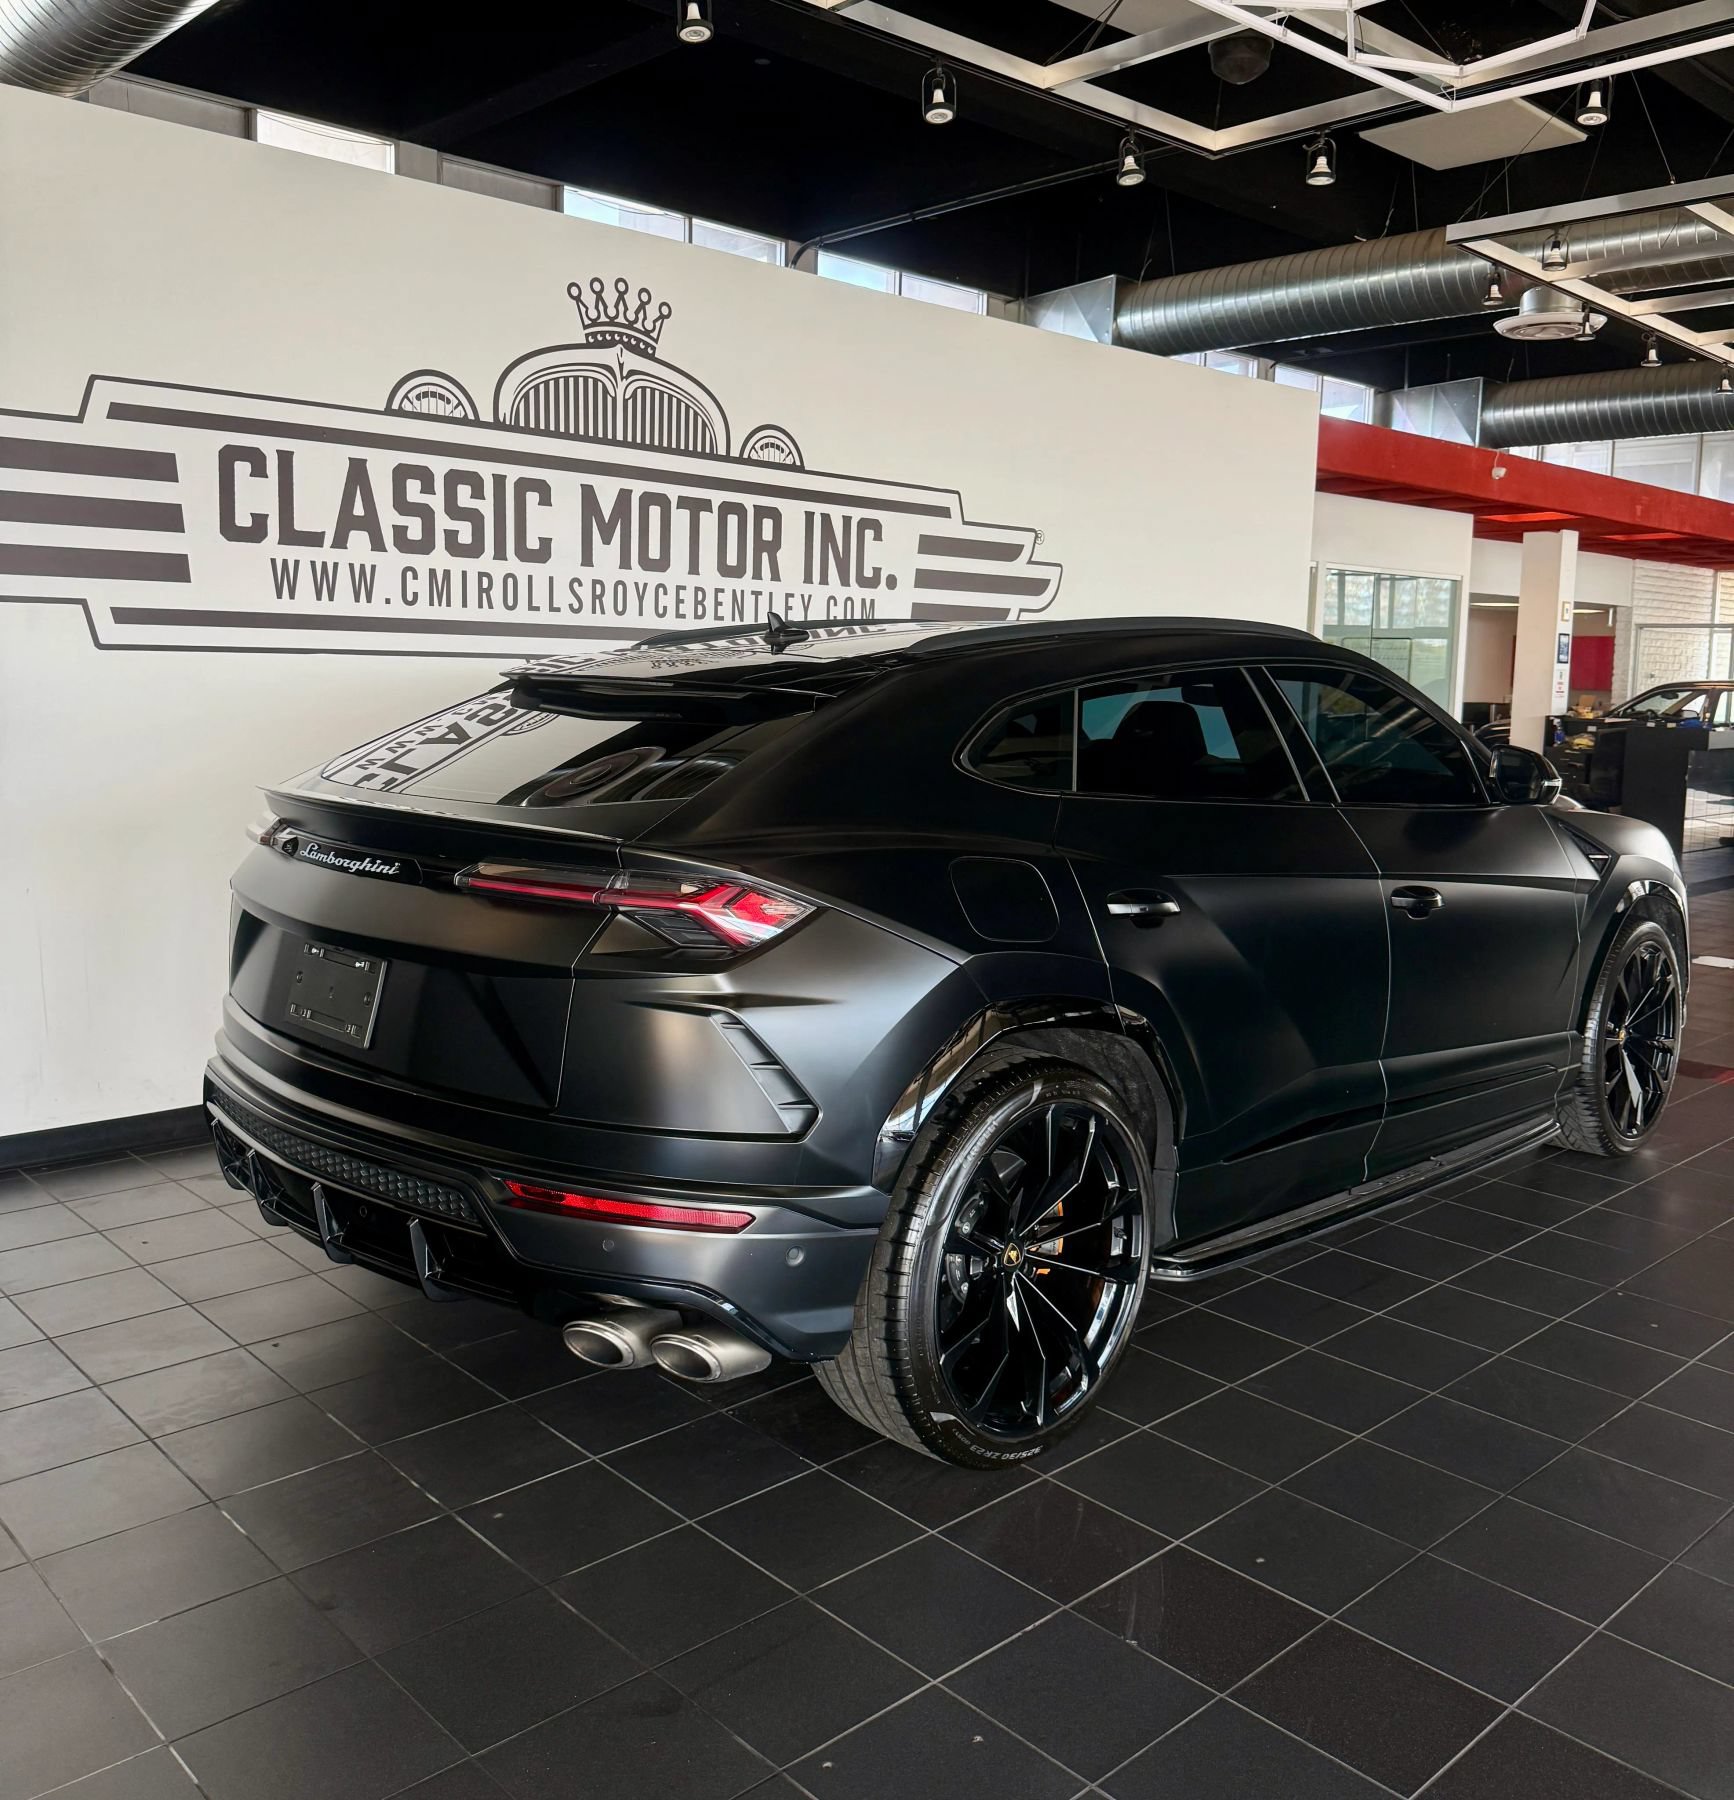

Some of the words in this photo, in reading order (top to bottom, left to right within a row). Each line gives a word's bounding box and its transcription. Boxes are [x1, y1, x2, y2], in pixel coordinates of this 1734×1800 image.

[218, 444, 553, 564] CLASSIC
[580, 483, 782, 582] MOTOR
[803, 509, 898, 591] INC.
[270, 557, 876, 623] WWW.CMIROLLSROYCEBENTEYCOM
[300, 843, 400, 875] Lamborghini
